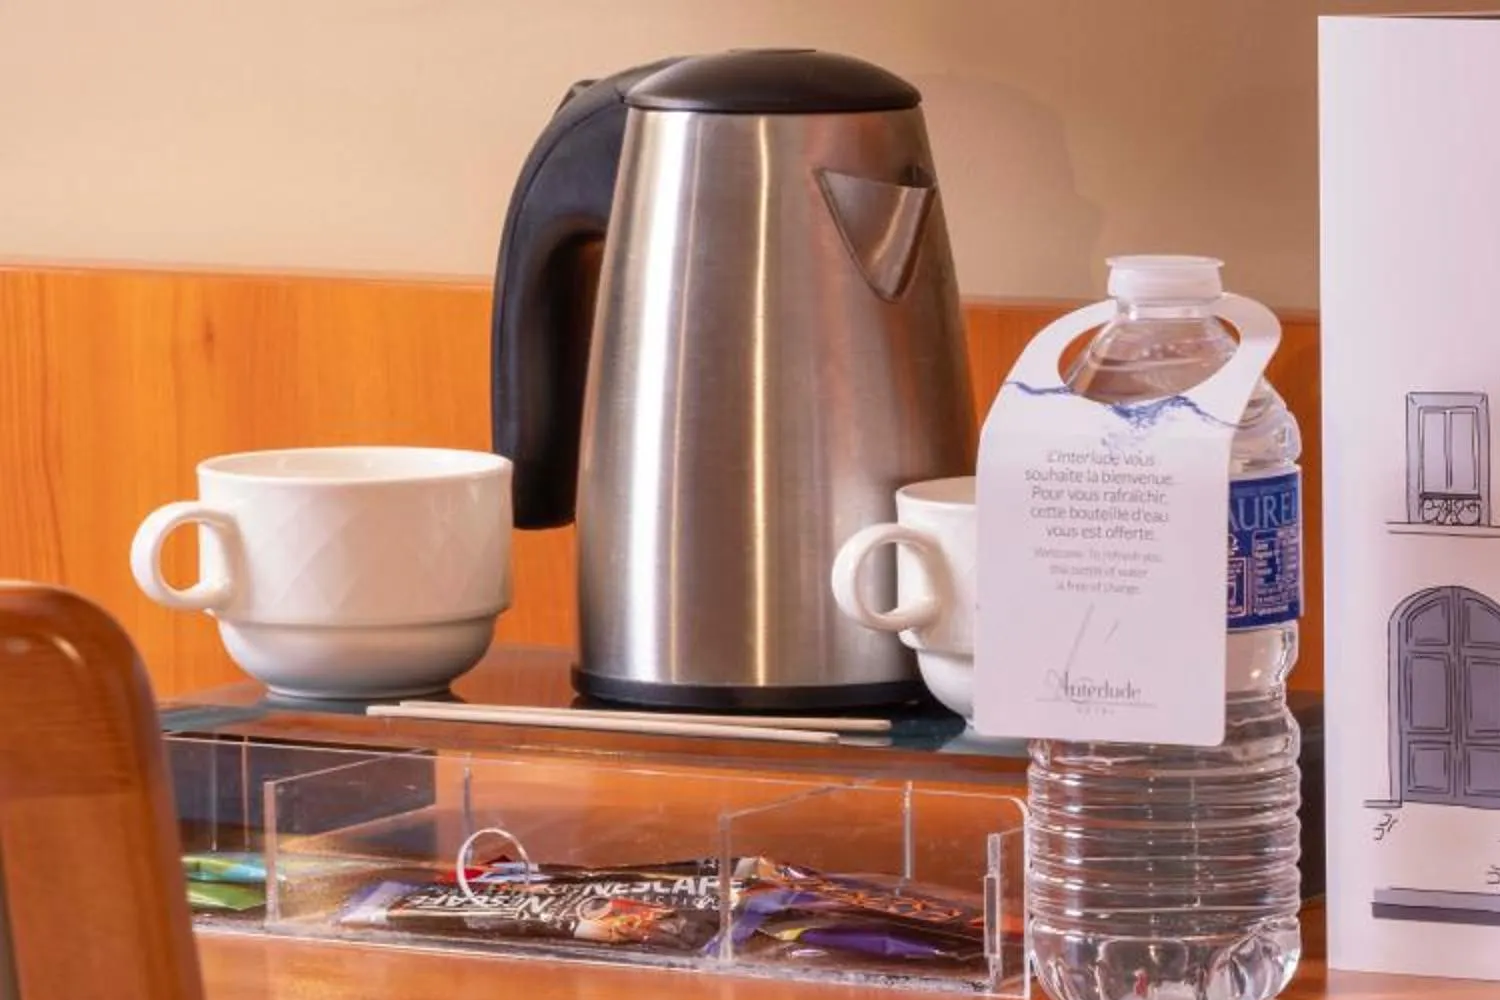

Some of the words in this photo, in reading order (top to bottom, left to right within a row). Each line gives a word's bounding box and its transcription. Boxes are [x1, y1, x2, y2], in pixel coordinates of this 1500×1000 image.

[1025, 467, 1083, 483] souhaite
[1087, 469, 1098, 483] la
[1031, 485, 1064, 501] Pour
[1068, 489, 1100, 502] vous
[1030, 506, 1066, 519] cette
[1069, 506, 1130, 522] bouteille
[1046, 526, 1079, 538] vous
[1082, 526, 1102, 540] est
